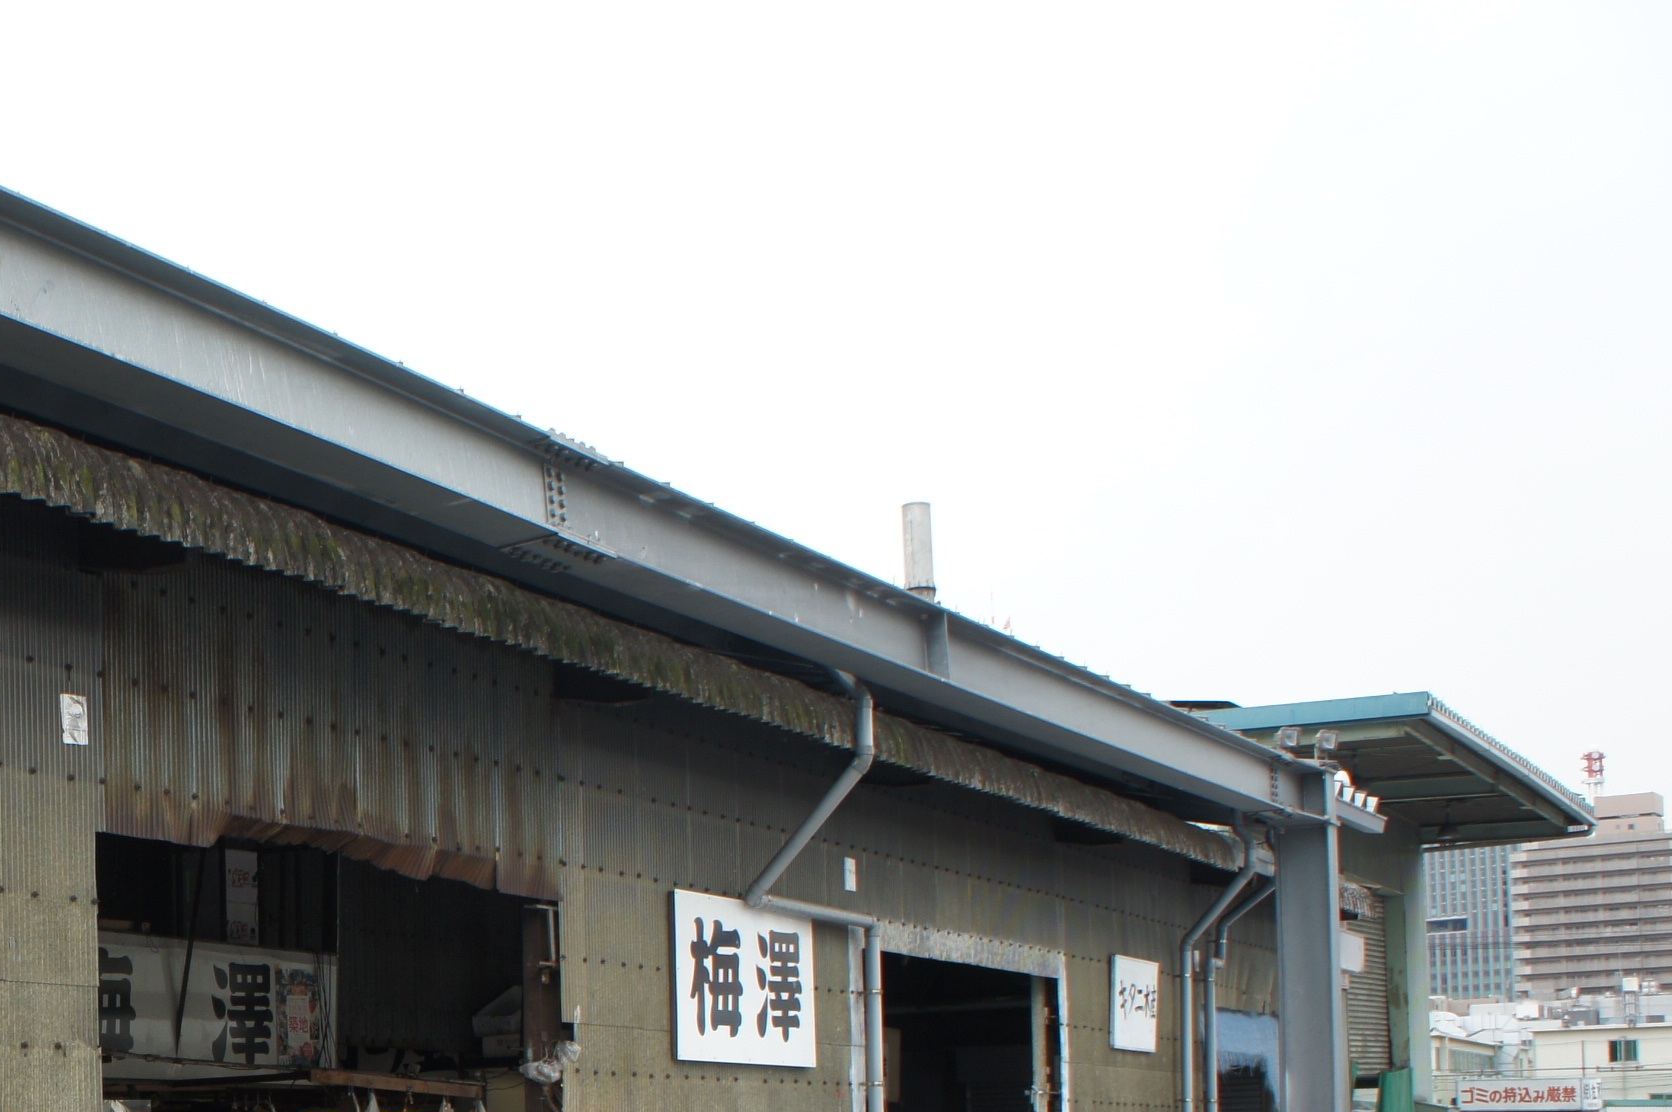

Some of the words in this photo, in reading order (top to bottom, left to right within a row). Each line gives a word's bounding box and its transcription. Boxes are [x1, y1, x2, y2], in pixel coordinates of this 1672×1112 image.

[690, 916, 803, 1043] 梅澤
[1461, 1086, 1577, 1104] ゴミの持込み厳禁
